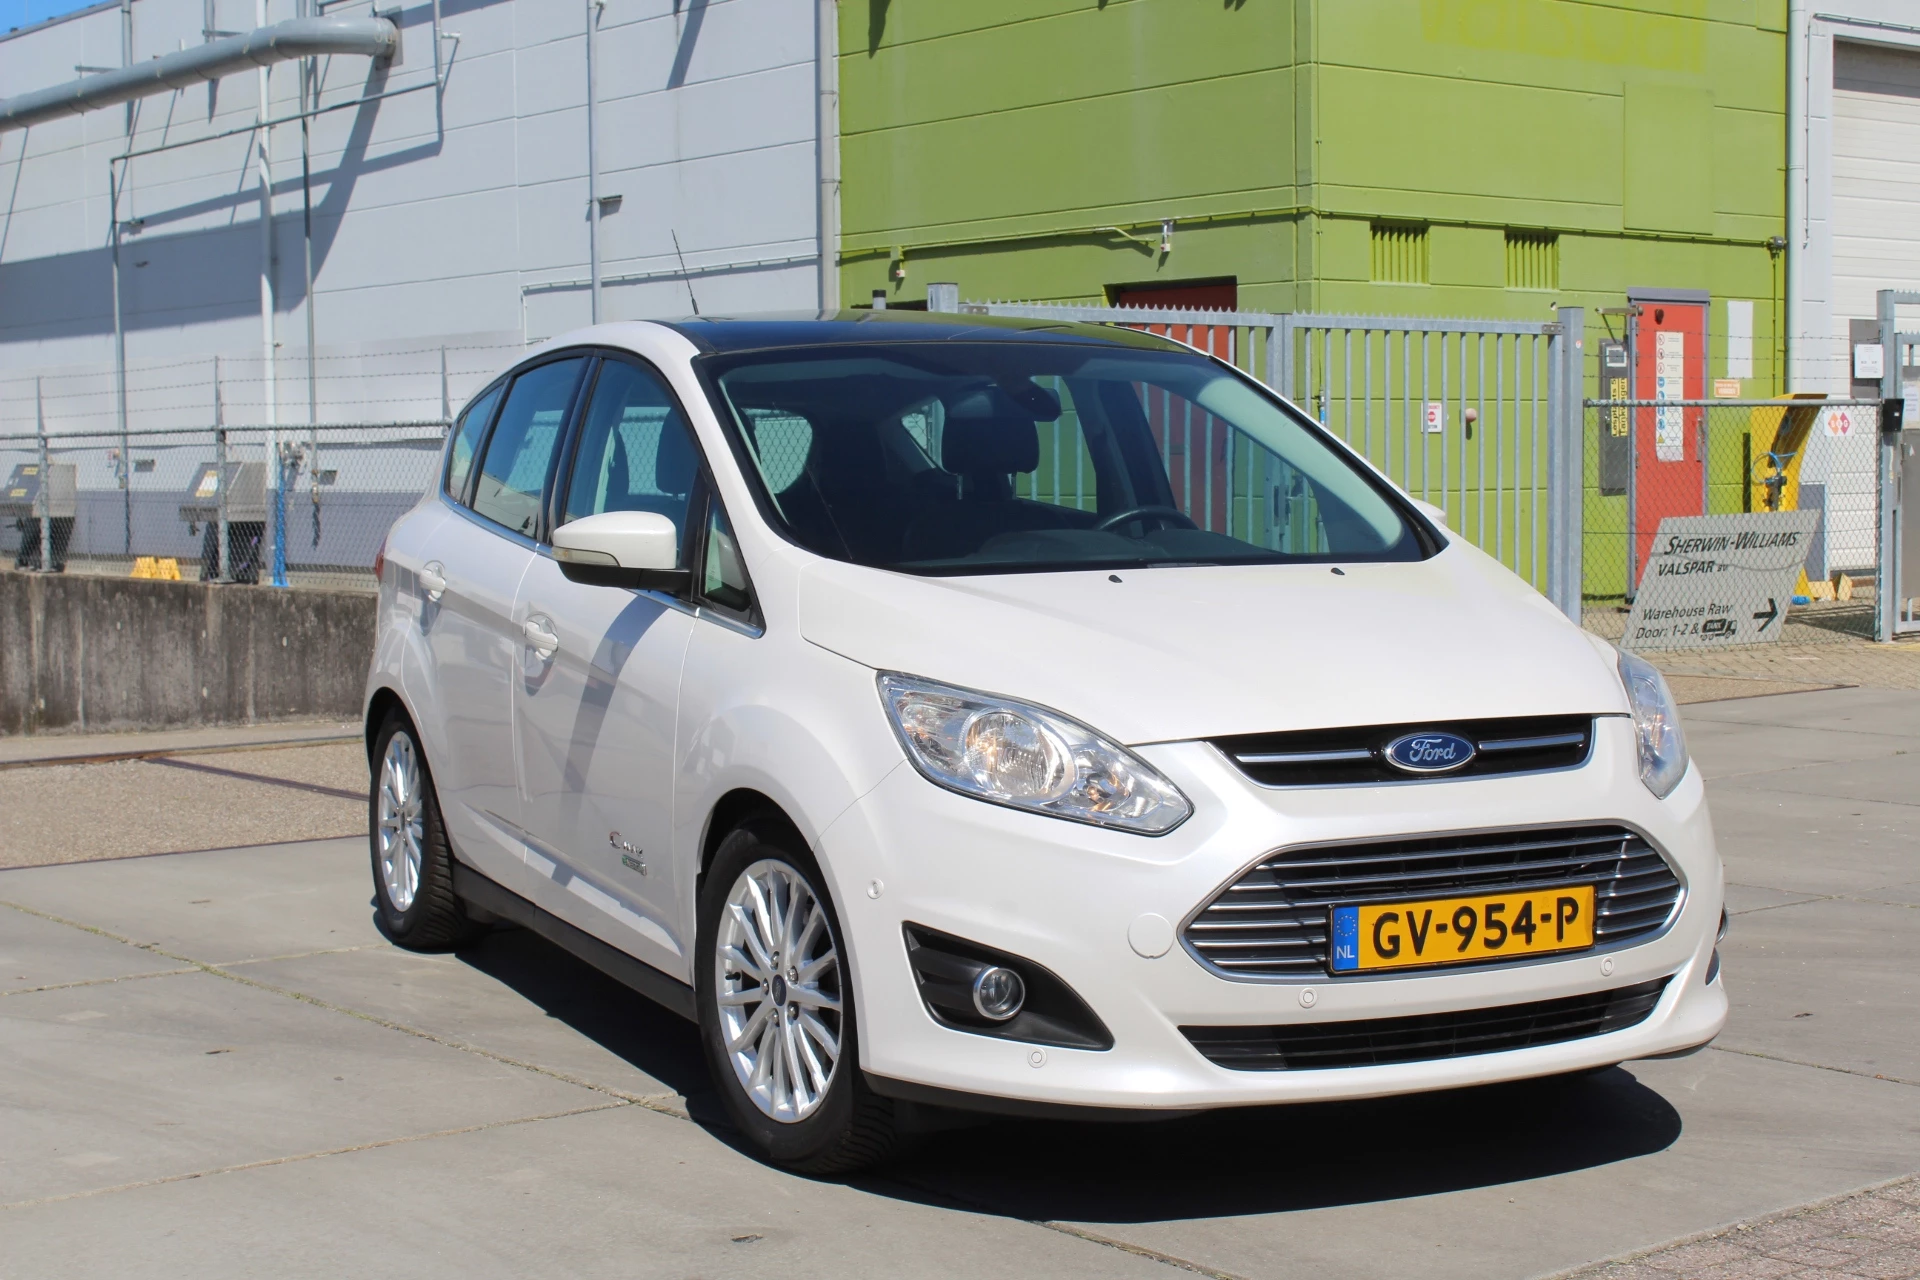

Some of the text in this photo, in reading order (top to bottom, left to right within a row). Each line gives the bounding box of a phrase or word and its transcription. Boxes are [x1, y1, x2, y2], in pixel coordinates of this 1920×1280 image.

[1664, 531, 1800, 555] SHERWIN-WILLIAMS
[1658, 561, 1715, 577] VALSPAR
[1643, 603, 1733, 621] Warehouse Raw
[1636, 624, 1699, 640] Door: 1-2 &
[1409, 738, 1456, 762] Ford
[1372, 896, 1579, 960] GV-954-P
[1336, 945, 1355, 959] NL
